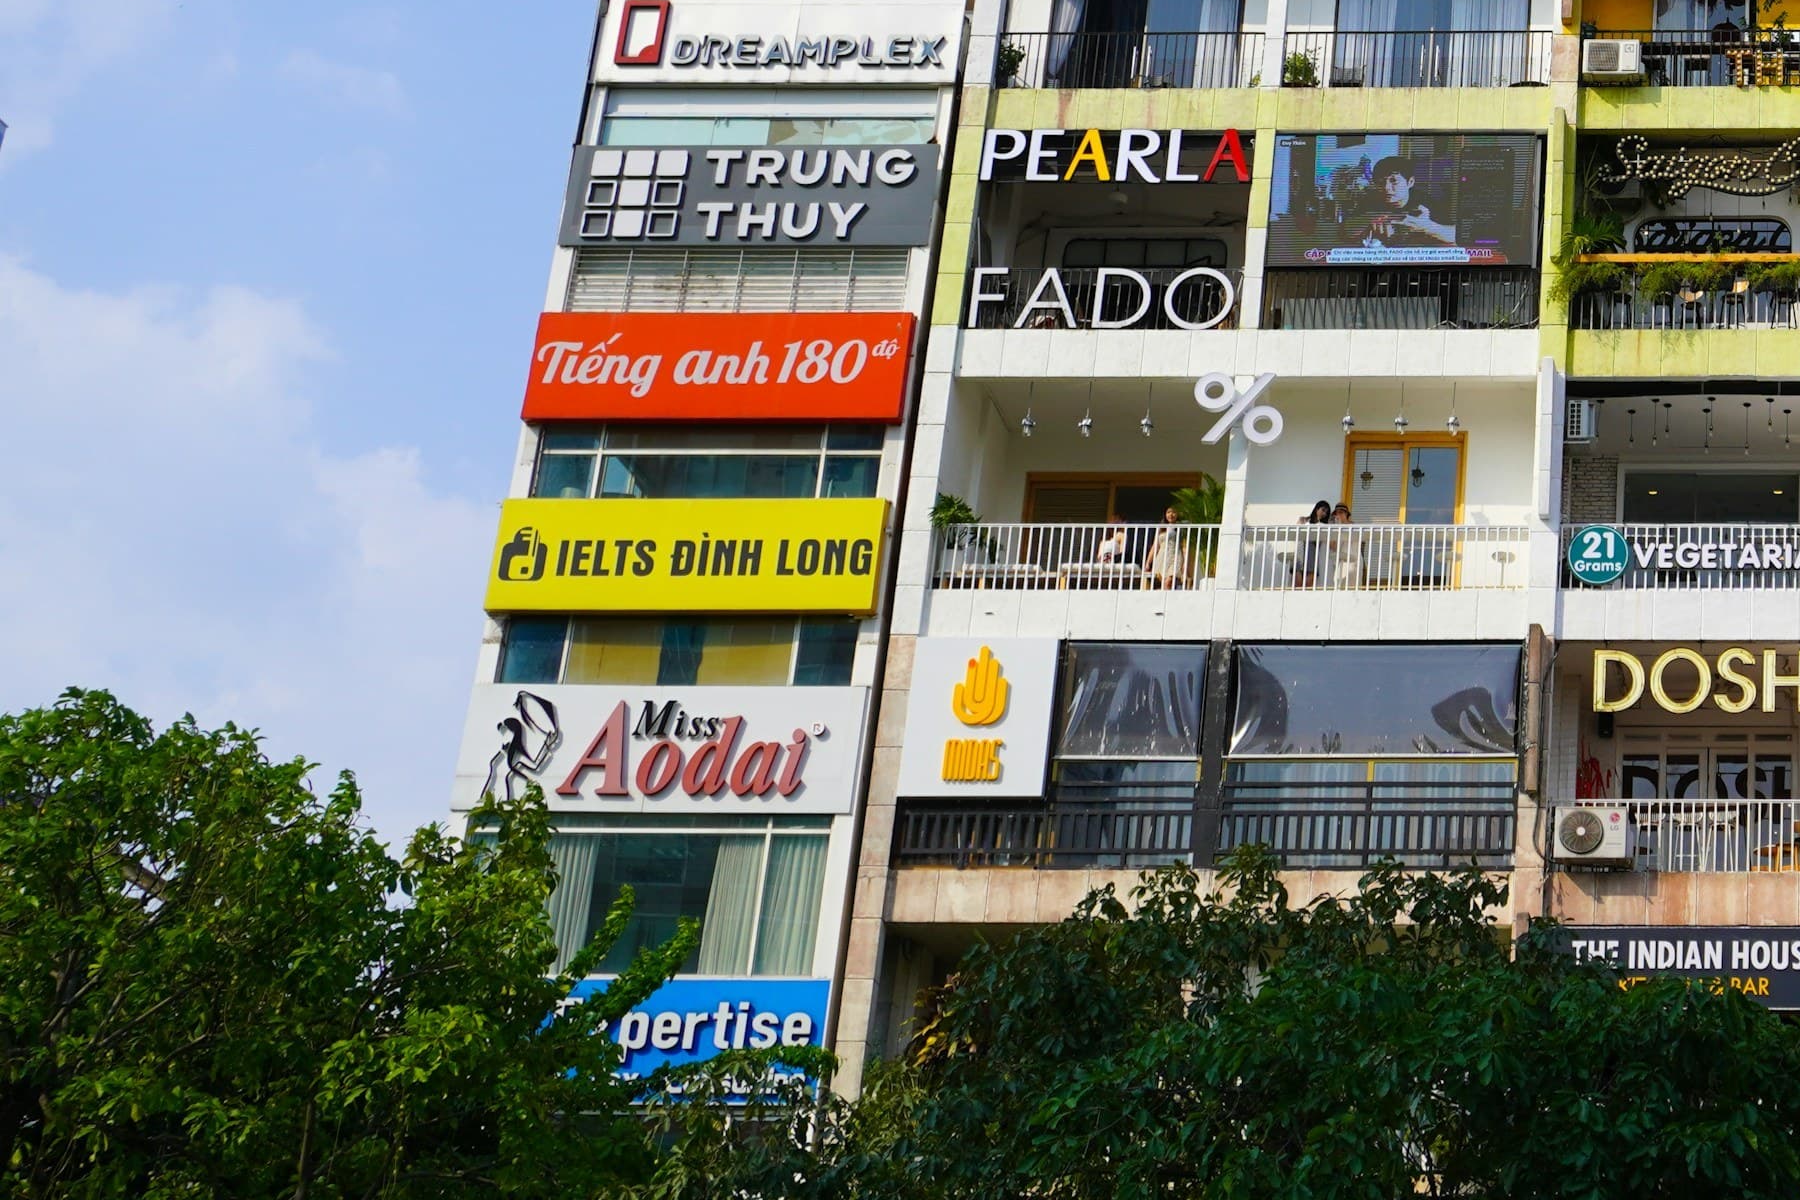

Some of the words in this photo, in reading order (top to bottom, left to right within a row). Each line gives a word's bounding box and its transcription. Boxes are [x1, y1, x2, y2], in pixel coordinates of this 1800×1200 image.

[670, 34, 946, 67] DREAMPLEX
[706, 149, 917, 186] TRUNG
[979, 128, 1251, 184] PEARLA
[697, 202, 869, 239] THUY
[967, 266, 1235, 330] FADO
[537, 332, 662, 399] Tiếng
[673, 343, 769, 386] anh
[776, 338, 867, 385] 180
[871, 338, 901, 359] độ
[556, 539, 657, 577] IELTS
[670, 532, 763, 577] ĐÌNH
[776, 538, 873, 576] LONG
[1582, 531, 1614, 560] 21
[1574, 559, 1623, 573] Grams
[632, 699, 722, 738] Miss
[556, 699, 811, 798] Aodai
[1572, 940, 1619, 969] THE
[1628, 940, 1722, 970] INDIAN
[553, 997, 814, 1064] pertise
